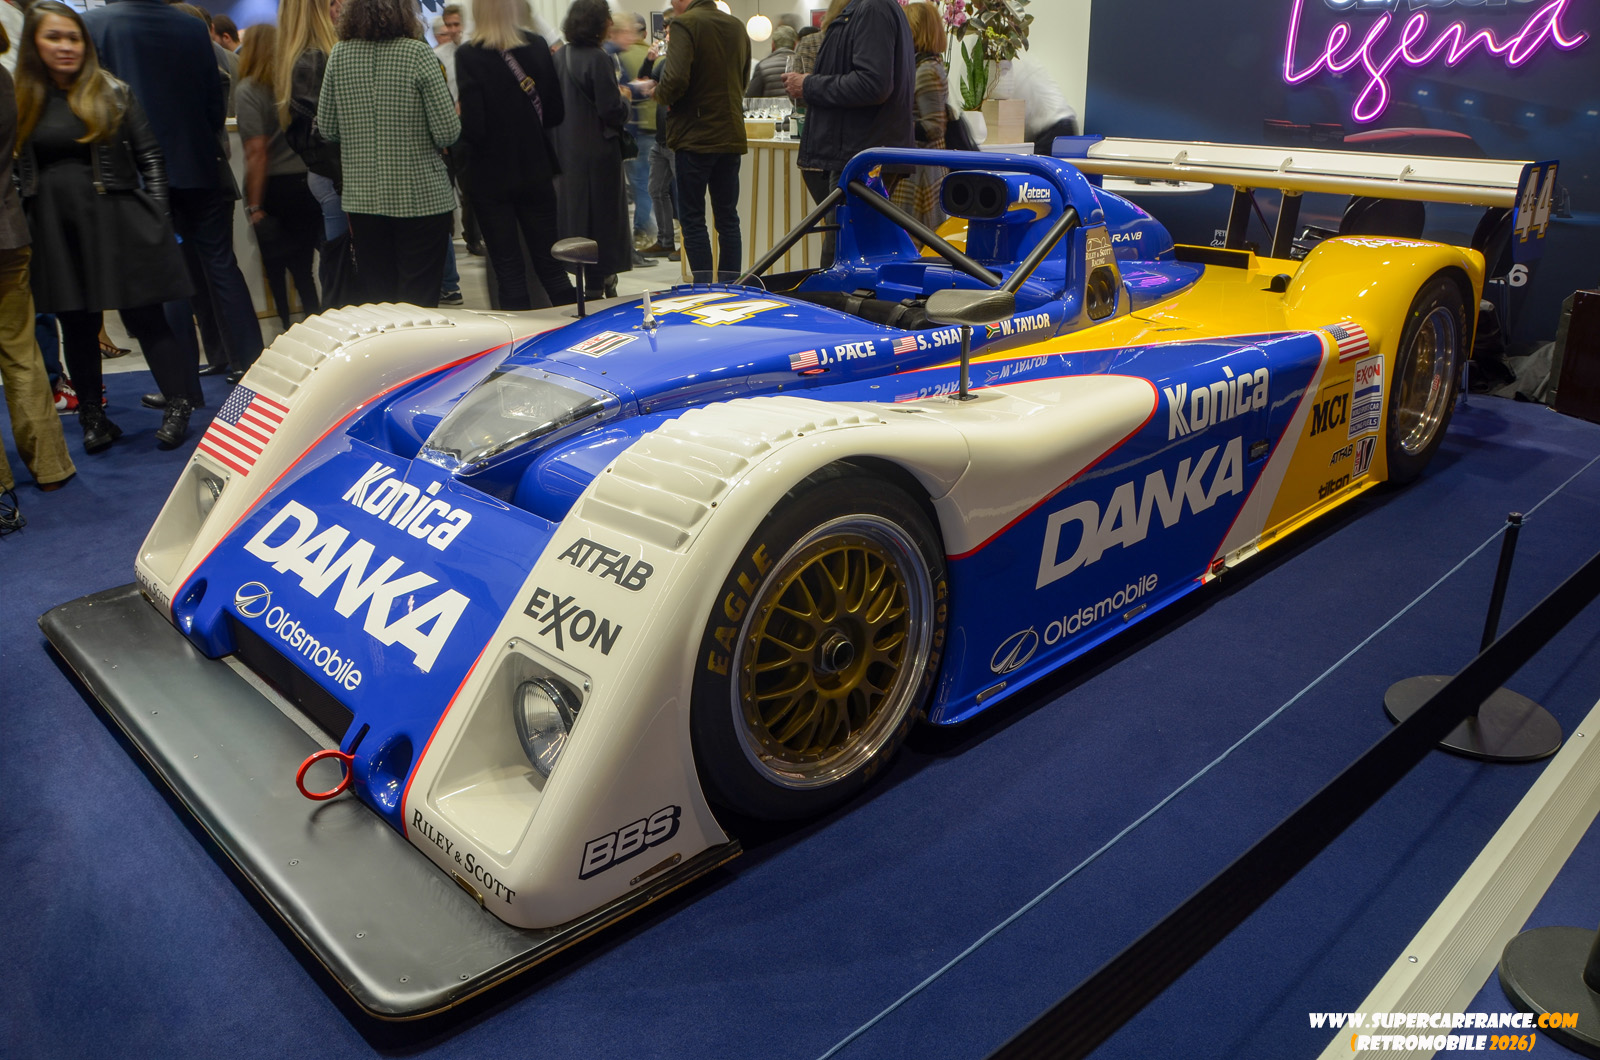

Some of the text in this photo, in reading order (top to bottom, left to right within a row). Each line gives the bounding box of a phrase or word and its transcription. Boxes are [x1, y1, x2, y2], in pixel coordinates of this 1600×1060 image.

[1284, 0, 1588, 121] Legend
[1514, 165, 1557, 243] 44
[1100, 248, 1112, 257] SCOTT
[1111, 232, 1131, 243] RA
[634, 291, 791, 328] 44
[1000, 312, 1051, 336] W. TAYLOR
[820, 340, 877, 366] J. PACE
[916, 334, 932, 351] S.
[1356, 363, 1381, 384] EXXON
[1164, 365, 1269, 441] Konica
[1310, 392, 1349, 438] MCI
[1370, 402, 1380, 410] CAR
[1330, 444, 1353, 467] ATFAB
[341, 461, 473, 551] Konica
[1035, 435, 1243, 591] DANKA
[1318, 474, 1350, 500] tilton
[243, 499, 471, 673] DANKA
[557, 537, 654, 592] ATFAB
[152, 582, 170, 608] SCOTT
[523, 587, 623, 656] EXXON
[707, 543, 773, 676] EAGLE
[1044, 574, 1158, 645] Oldsmobile
[265, 606, 362, 691] Oldsmobile
[412, 808, 516, 905] RILEY & SCOTT
[578, 805, 682, 880] BBS
